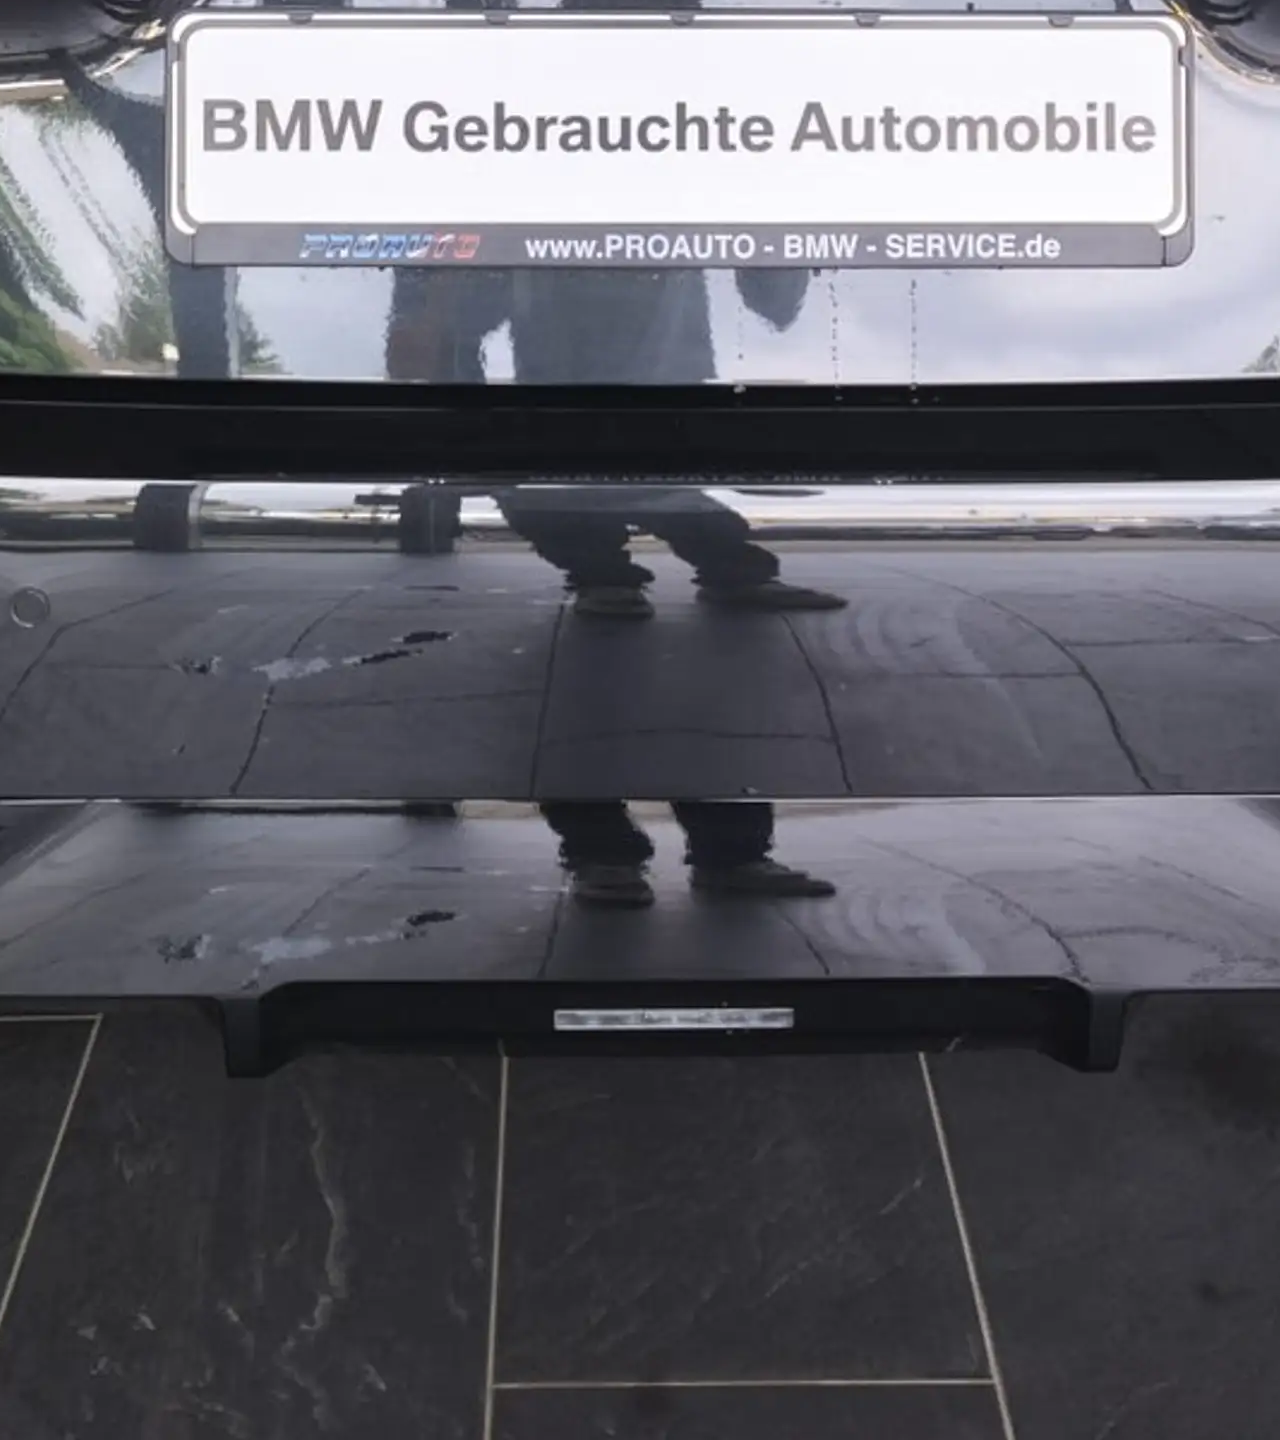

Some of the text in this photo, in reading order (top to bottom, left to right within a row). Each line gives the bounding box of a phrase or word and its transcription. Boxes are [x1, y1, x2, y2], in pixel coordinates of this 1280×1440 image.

[200, 97, 1158, 155] BMW Gebrauchte Automobile
[299, 233, 482, 259] PROAUTO
[524, 233, 756, 260] www.PROAUTO
[783, 233, 859, 258] BMW
[885, 232, 1061, 259] SERVICE.de
